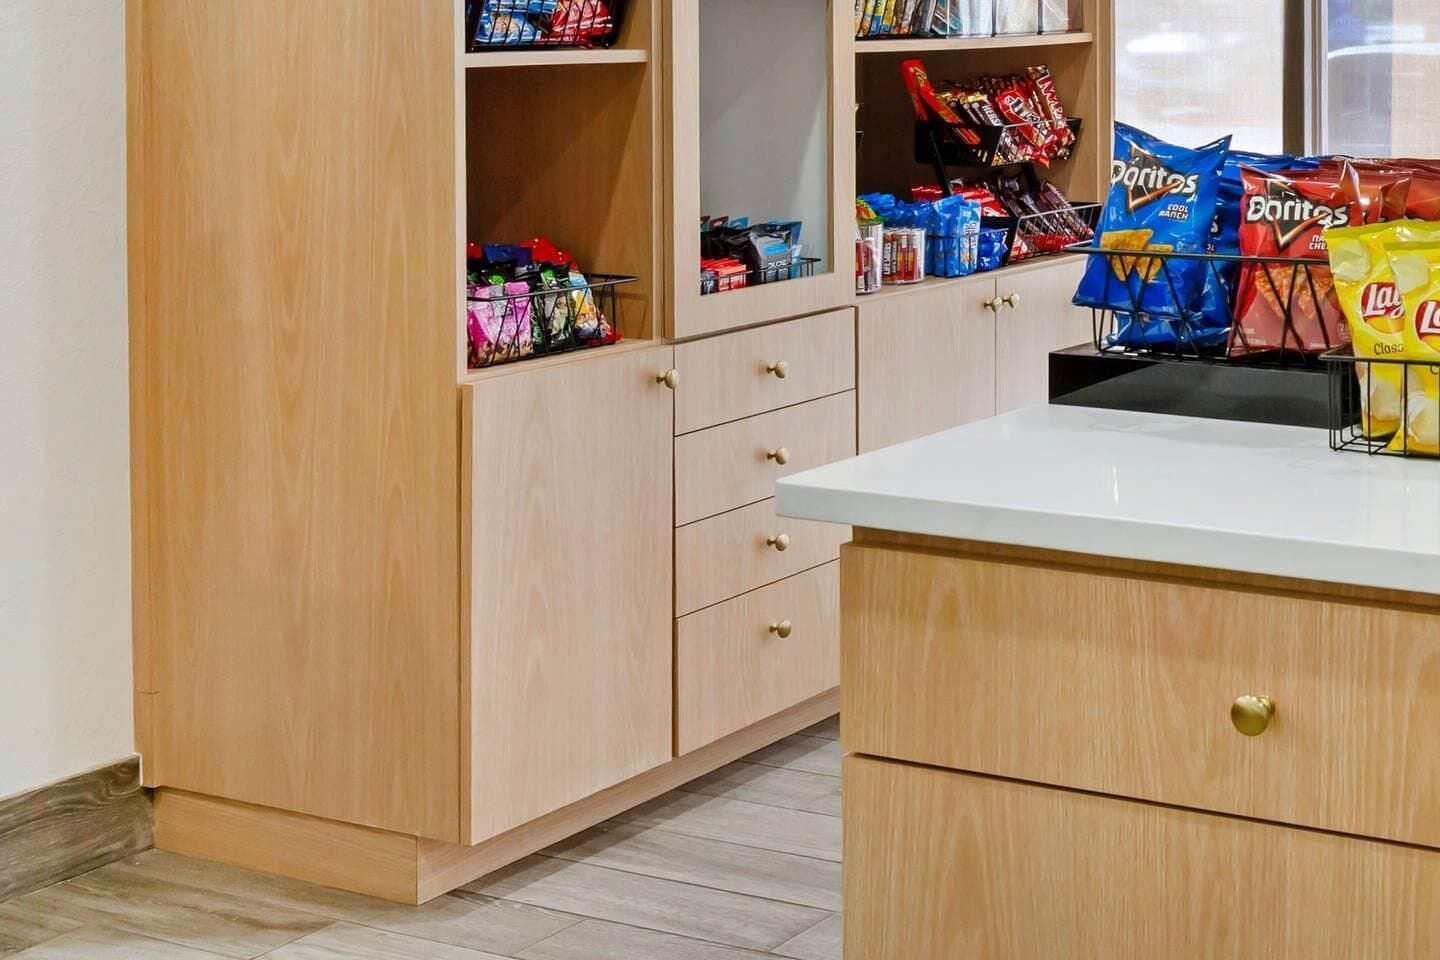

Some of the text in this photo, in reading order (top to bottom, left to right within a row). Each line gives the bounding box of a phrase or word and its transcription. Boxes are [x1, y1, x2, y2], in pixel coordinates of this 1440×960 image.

[1111, 159, 1200, 194] Doritos
[1158, 210, 1189, 220] RANCH
[1166, 203, 1188, 213] COOL
[1246, 195, 1349, 226] Doritos
